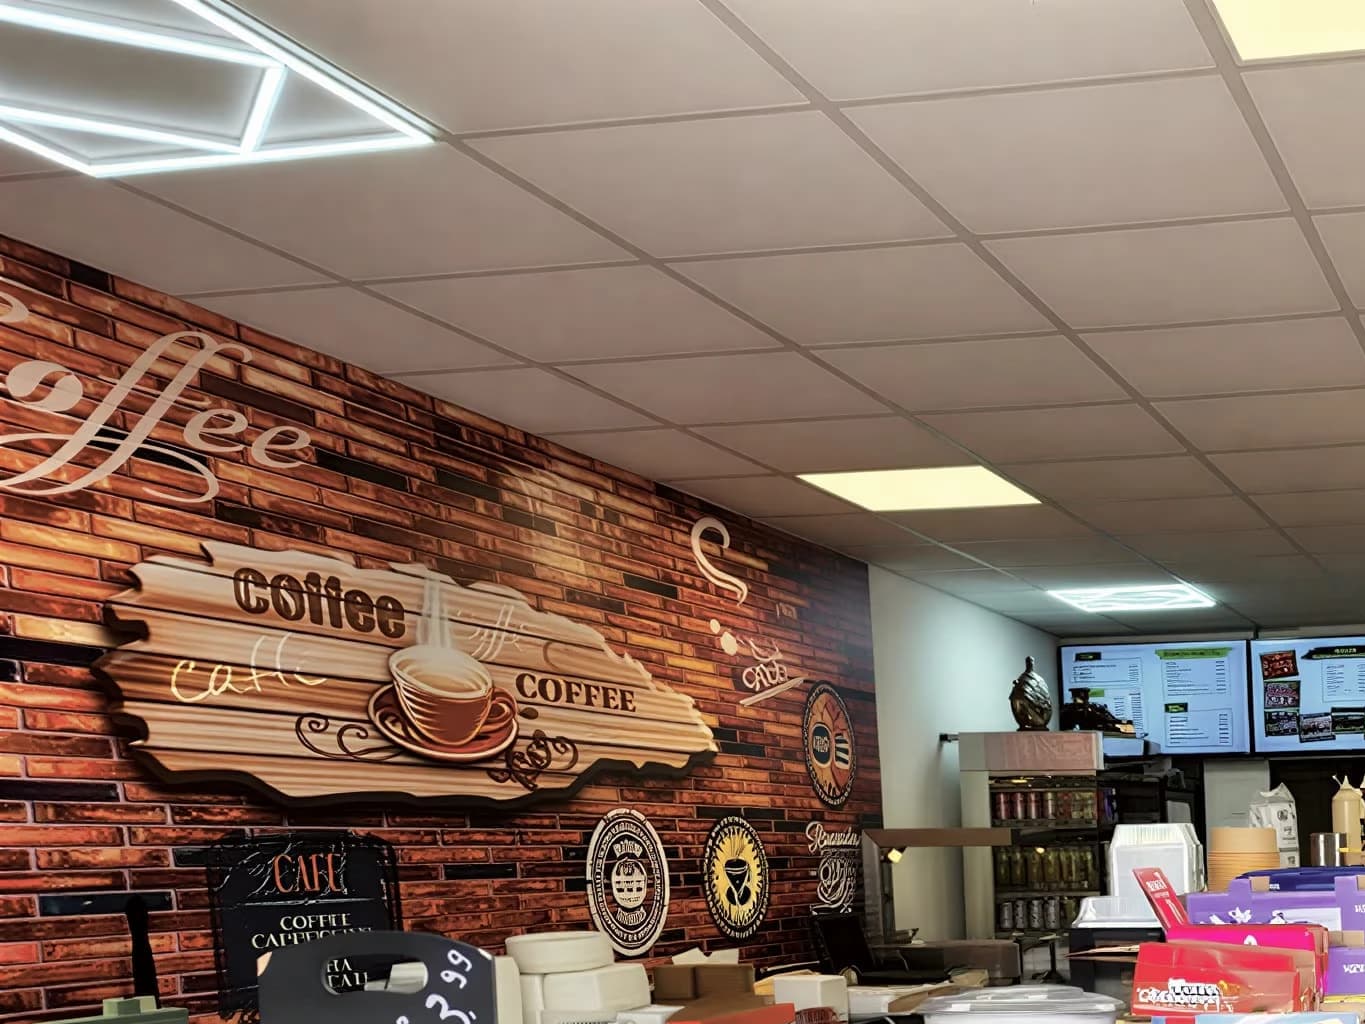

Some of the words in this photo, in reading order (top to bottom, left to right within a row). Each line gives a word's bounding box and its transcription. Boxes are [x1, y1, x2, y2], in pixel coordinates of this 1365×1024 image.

[0, 293, 314, 502] offee
[233, 567, 406, 639] coffee
[516, 673, 637, 713] COFFEE
